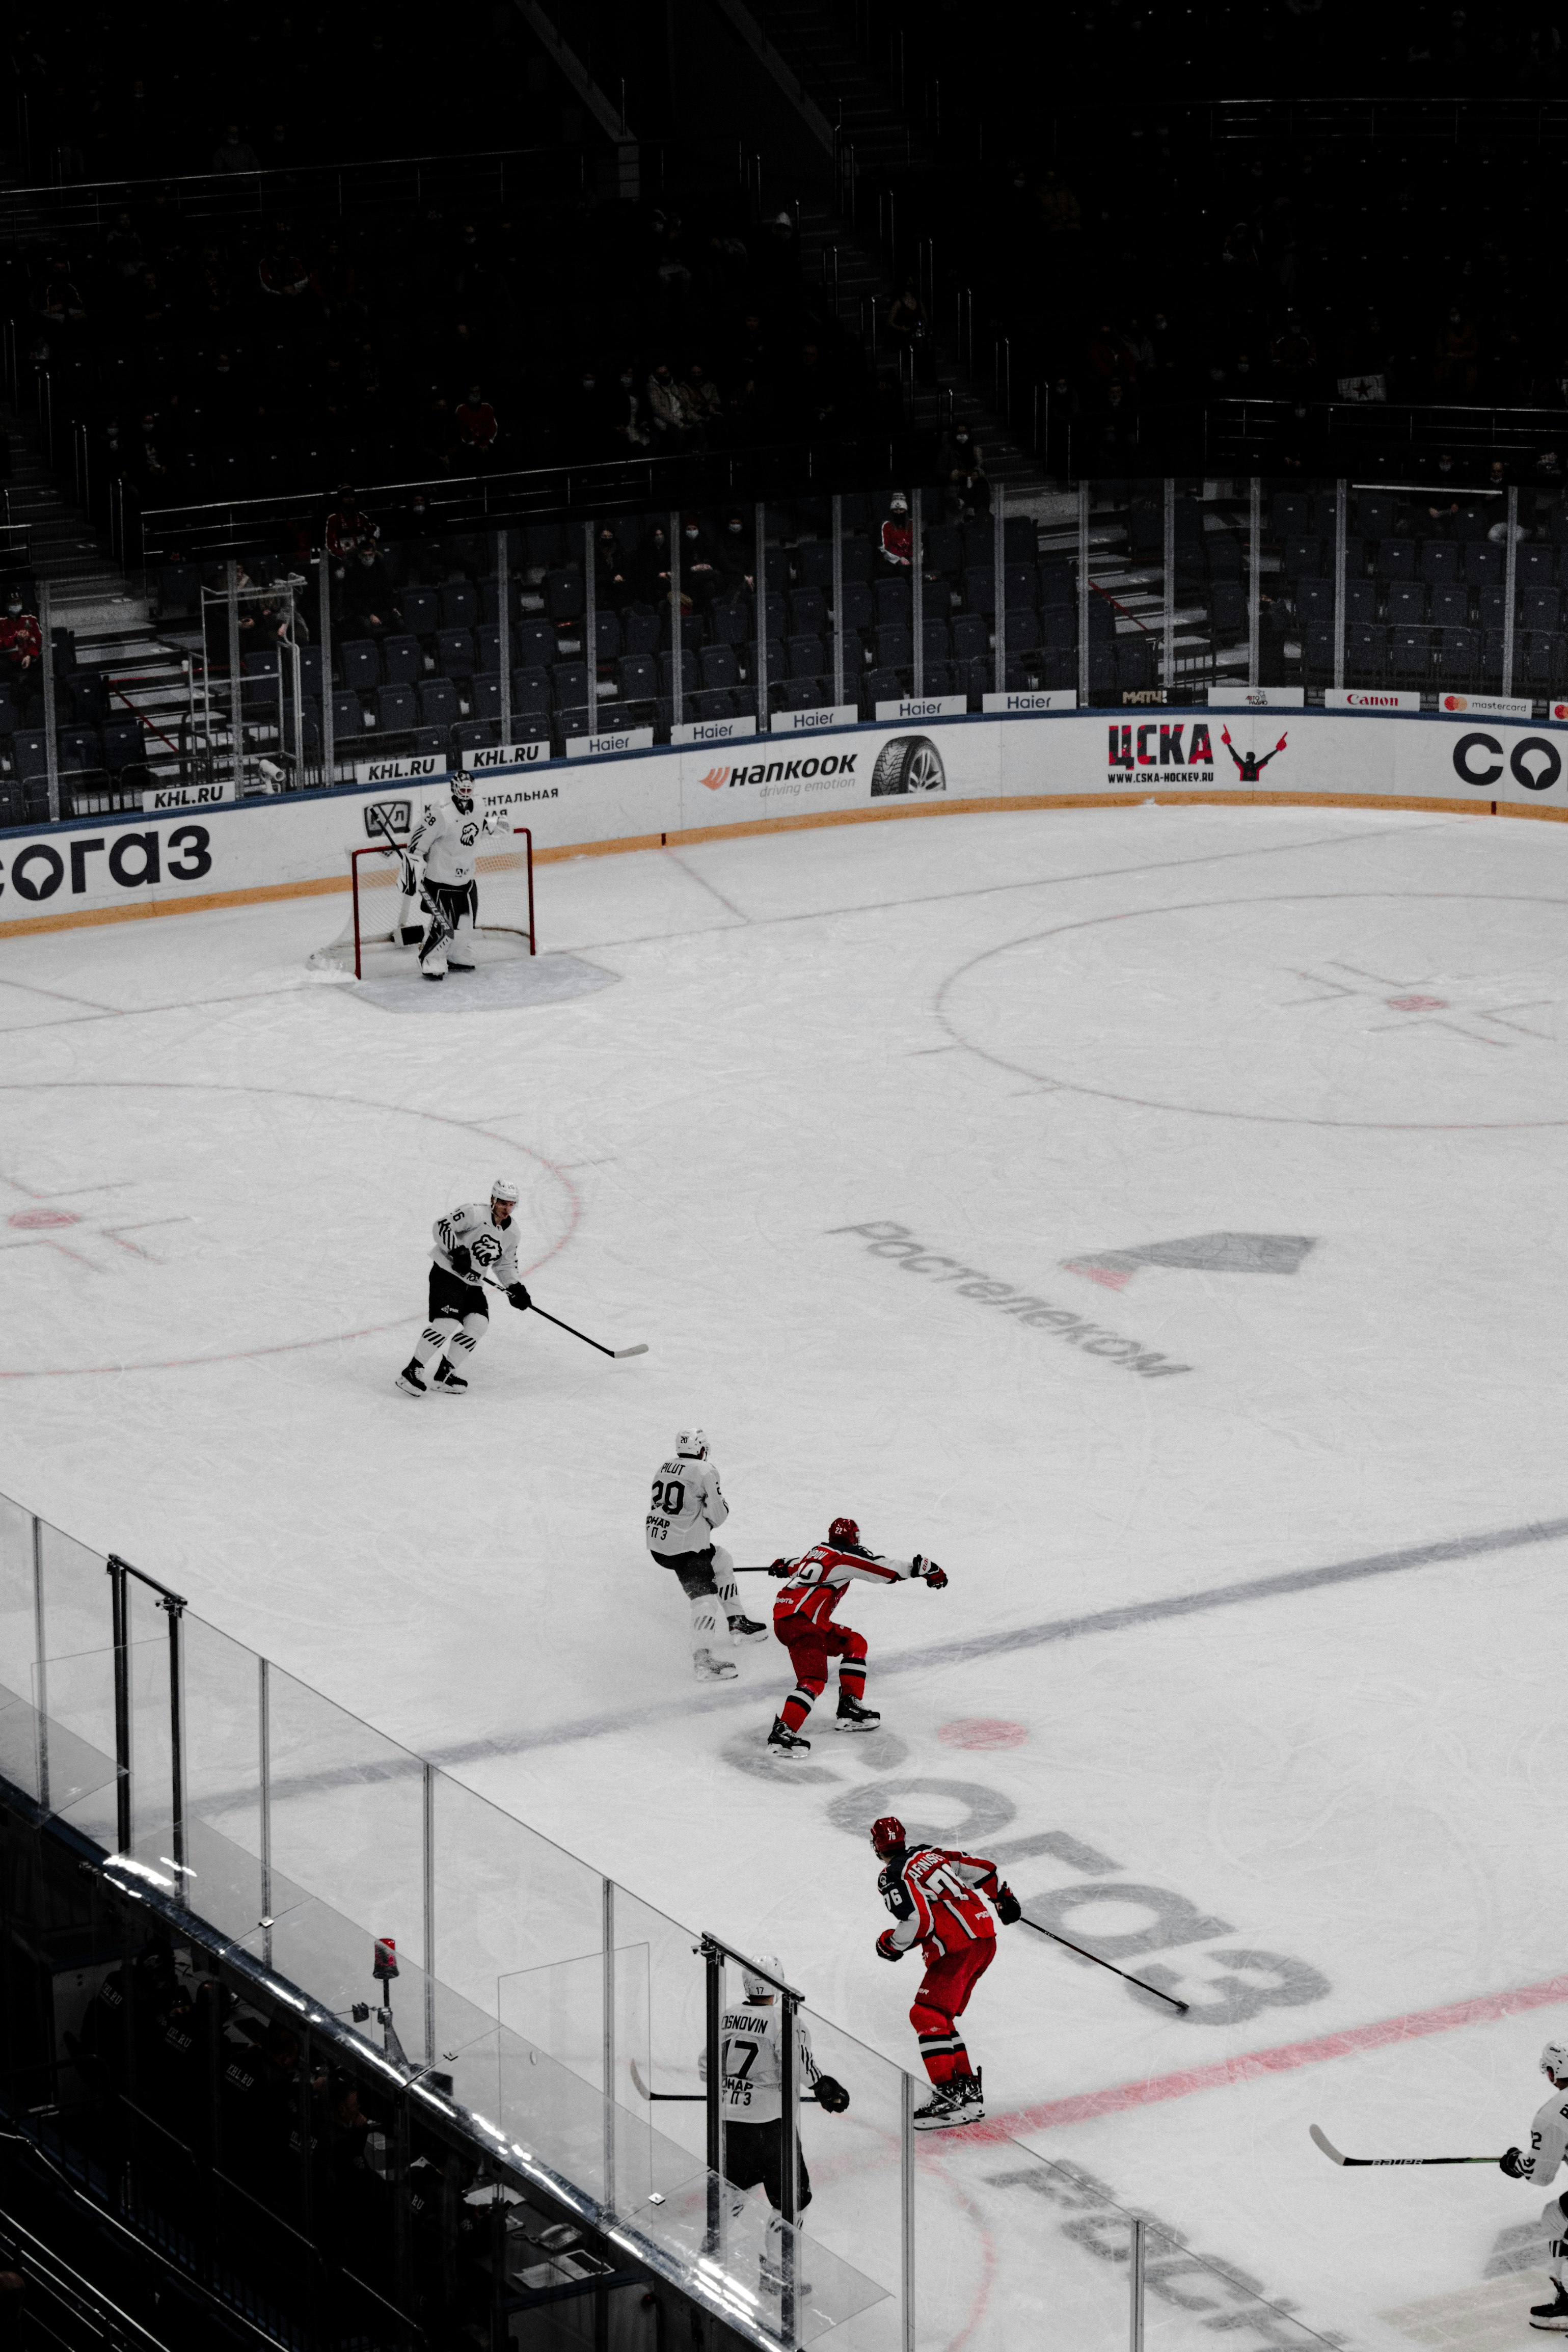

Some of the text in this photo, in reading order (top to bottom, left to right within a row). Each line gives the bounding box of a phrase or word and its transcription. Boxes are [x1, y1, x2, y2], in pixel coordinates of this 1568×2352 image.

[1008, 695, 1051, 709] Haier
[1346, 693, 1399, 707] Canon
[1472, 700, 1527, 713] mastercard
[900, 701, 941, 716] Haier
[794, 712, 833, 728] Haier
[693, 724, 733, 740] Haier
[589, 737, 629, 752] Haier
[1109, 724, 1214, 770] ЦСКА
[474, 746, 538, 767] KHL.RU
[369, 759, 435, 780] KHL.RU
[1108, 772, 1214, 783] WWW.CSKA-HOCKEY.RU
[760, 778, 855, 798] driving emotion
[155, 786, 223, 808] KHL.RU
[661, 1463, 685, 1476] PILUT
[651, 1480, 685, 1515] 20
[888, 1832, 896, 1840] 76
[883, 1888, 903, 1911] 76
